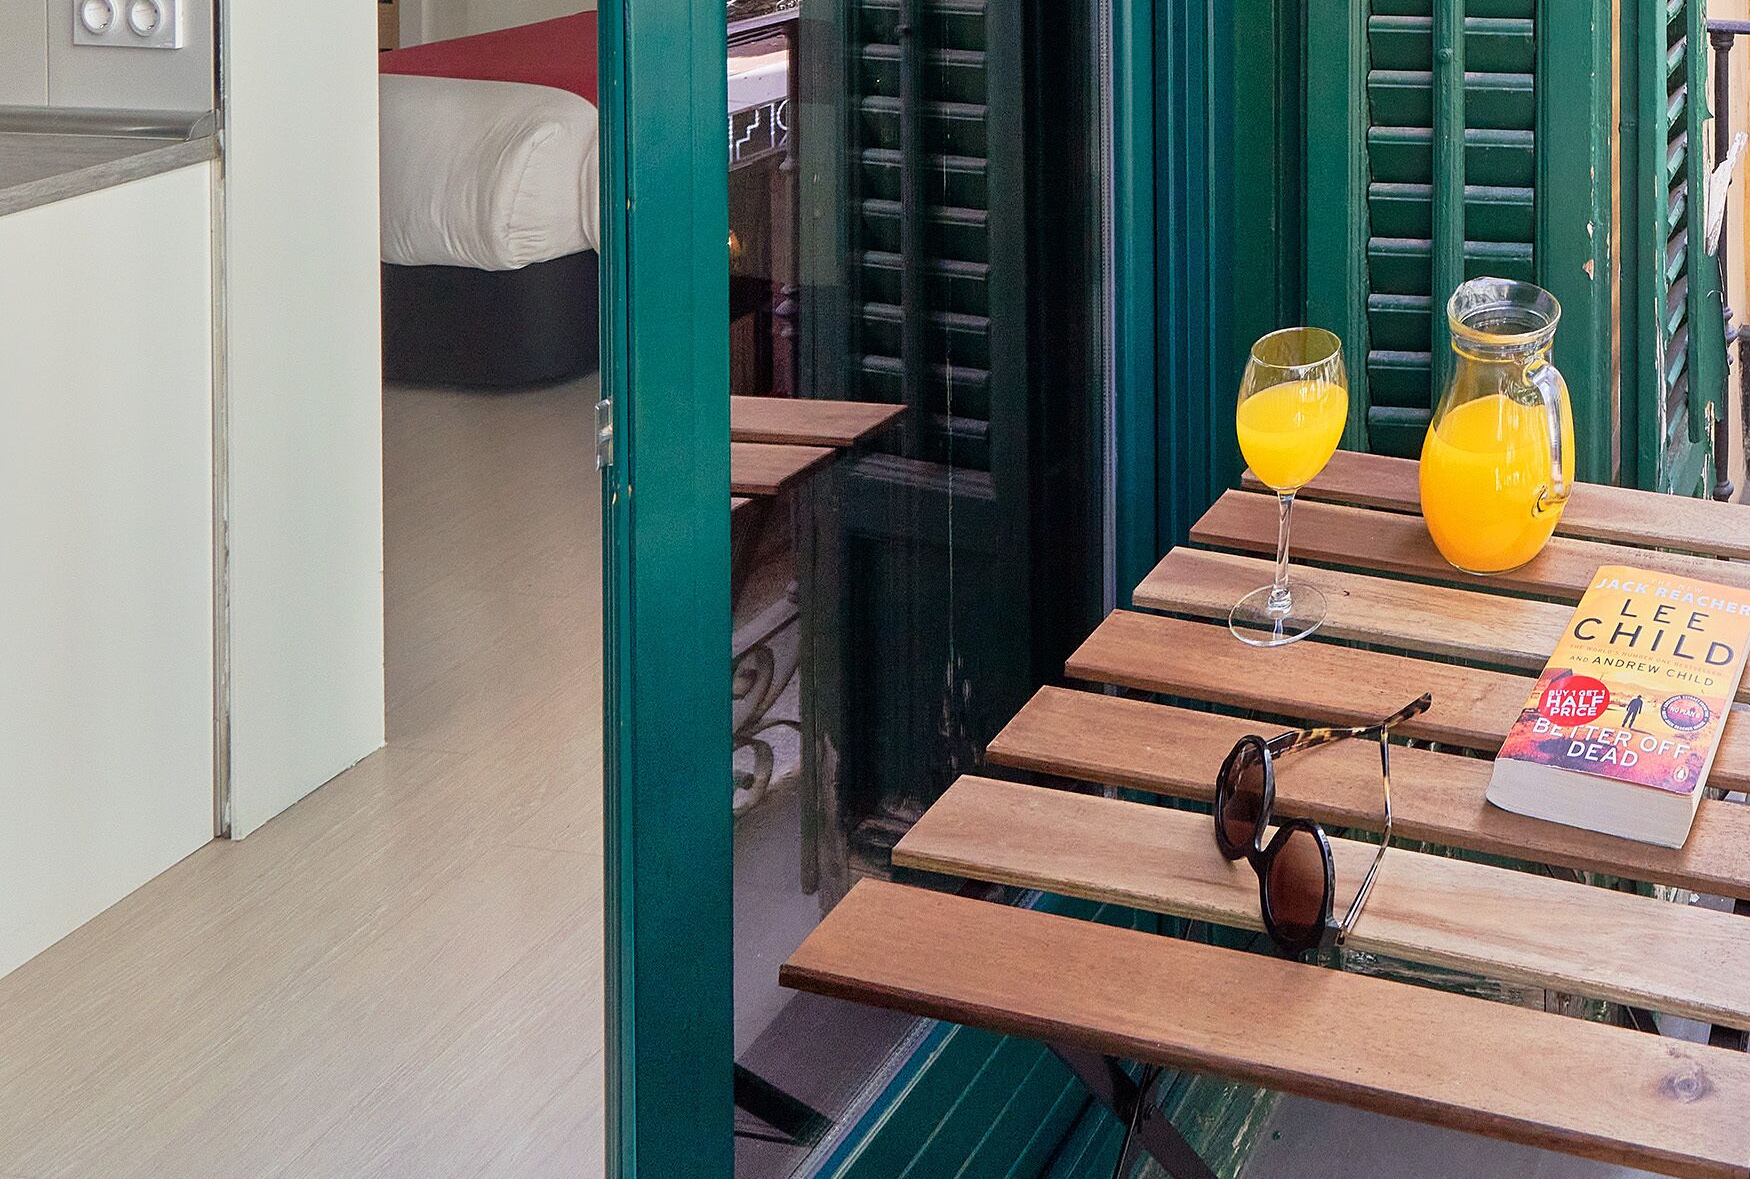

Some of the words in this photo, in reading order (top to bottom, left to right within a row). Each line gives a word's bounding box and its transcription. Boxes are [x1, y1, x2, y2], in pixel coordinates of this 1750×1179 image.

[1595, 578, 1649, 595] JACK
[1620, 598, 1710, 632] LEE
[1573, 617, 1734, 666] CHILD
[1569, 655, 1590, 663] AND
[1592, 656, 1661, 674] ANDREW
[1666, 668, 1714, 687] CHILD
[1546, 696, 1605, 708] HALF
[1550, 707, 1598, 717] PRICE
[1532, 717, 1632, 748] BETTER
[1639, 736, 1690, 759] OFF
[1567, 740, 1639, 768] DEAD
